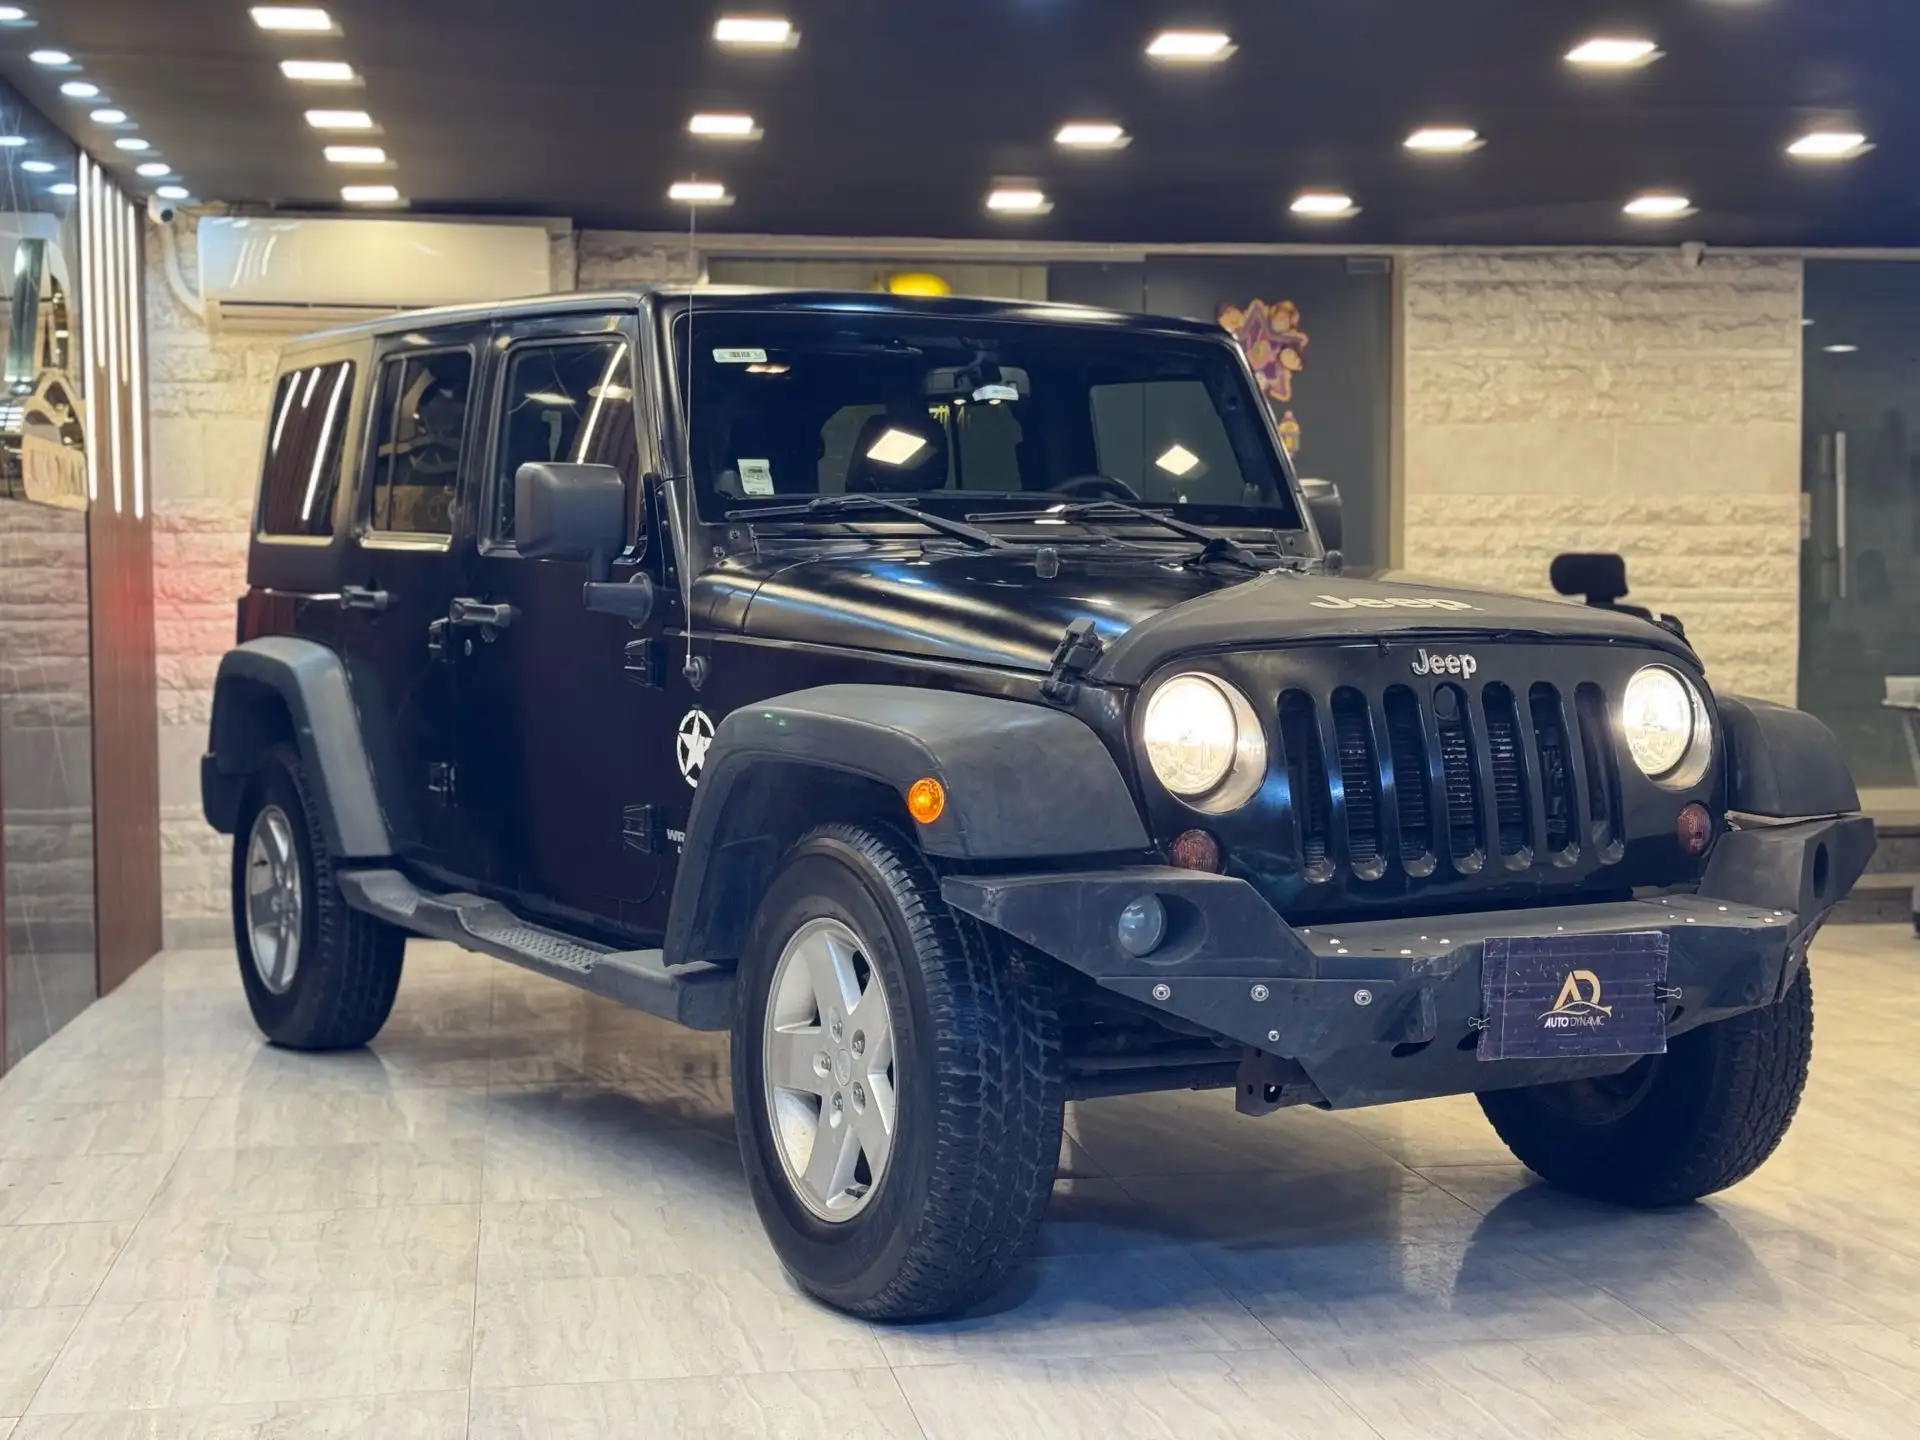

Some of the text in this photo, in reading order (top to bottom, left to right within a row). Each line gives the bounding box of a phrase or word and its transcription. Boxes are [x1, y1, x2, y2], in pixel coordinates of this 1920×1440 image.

[1310, 595, 1472, 611] Jeep
[1412, 649, 1477, 680] Jeep
[666, 829, 686, 842] WR
[1544, 1016, 1569, 1028] AUTO
